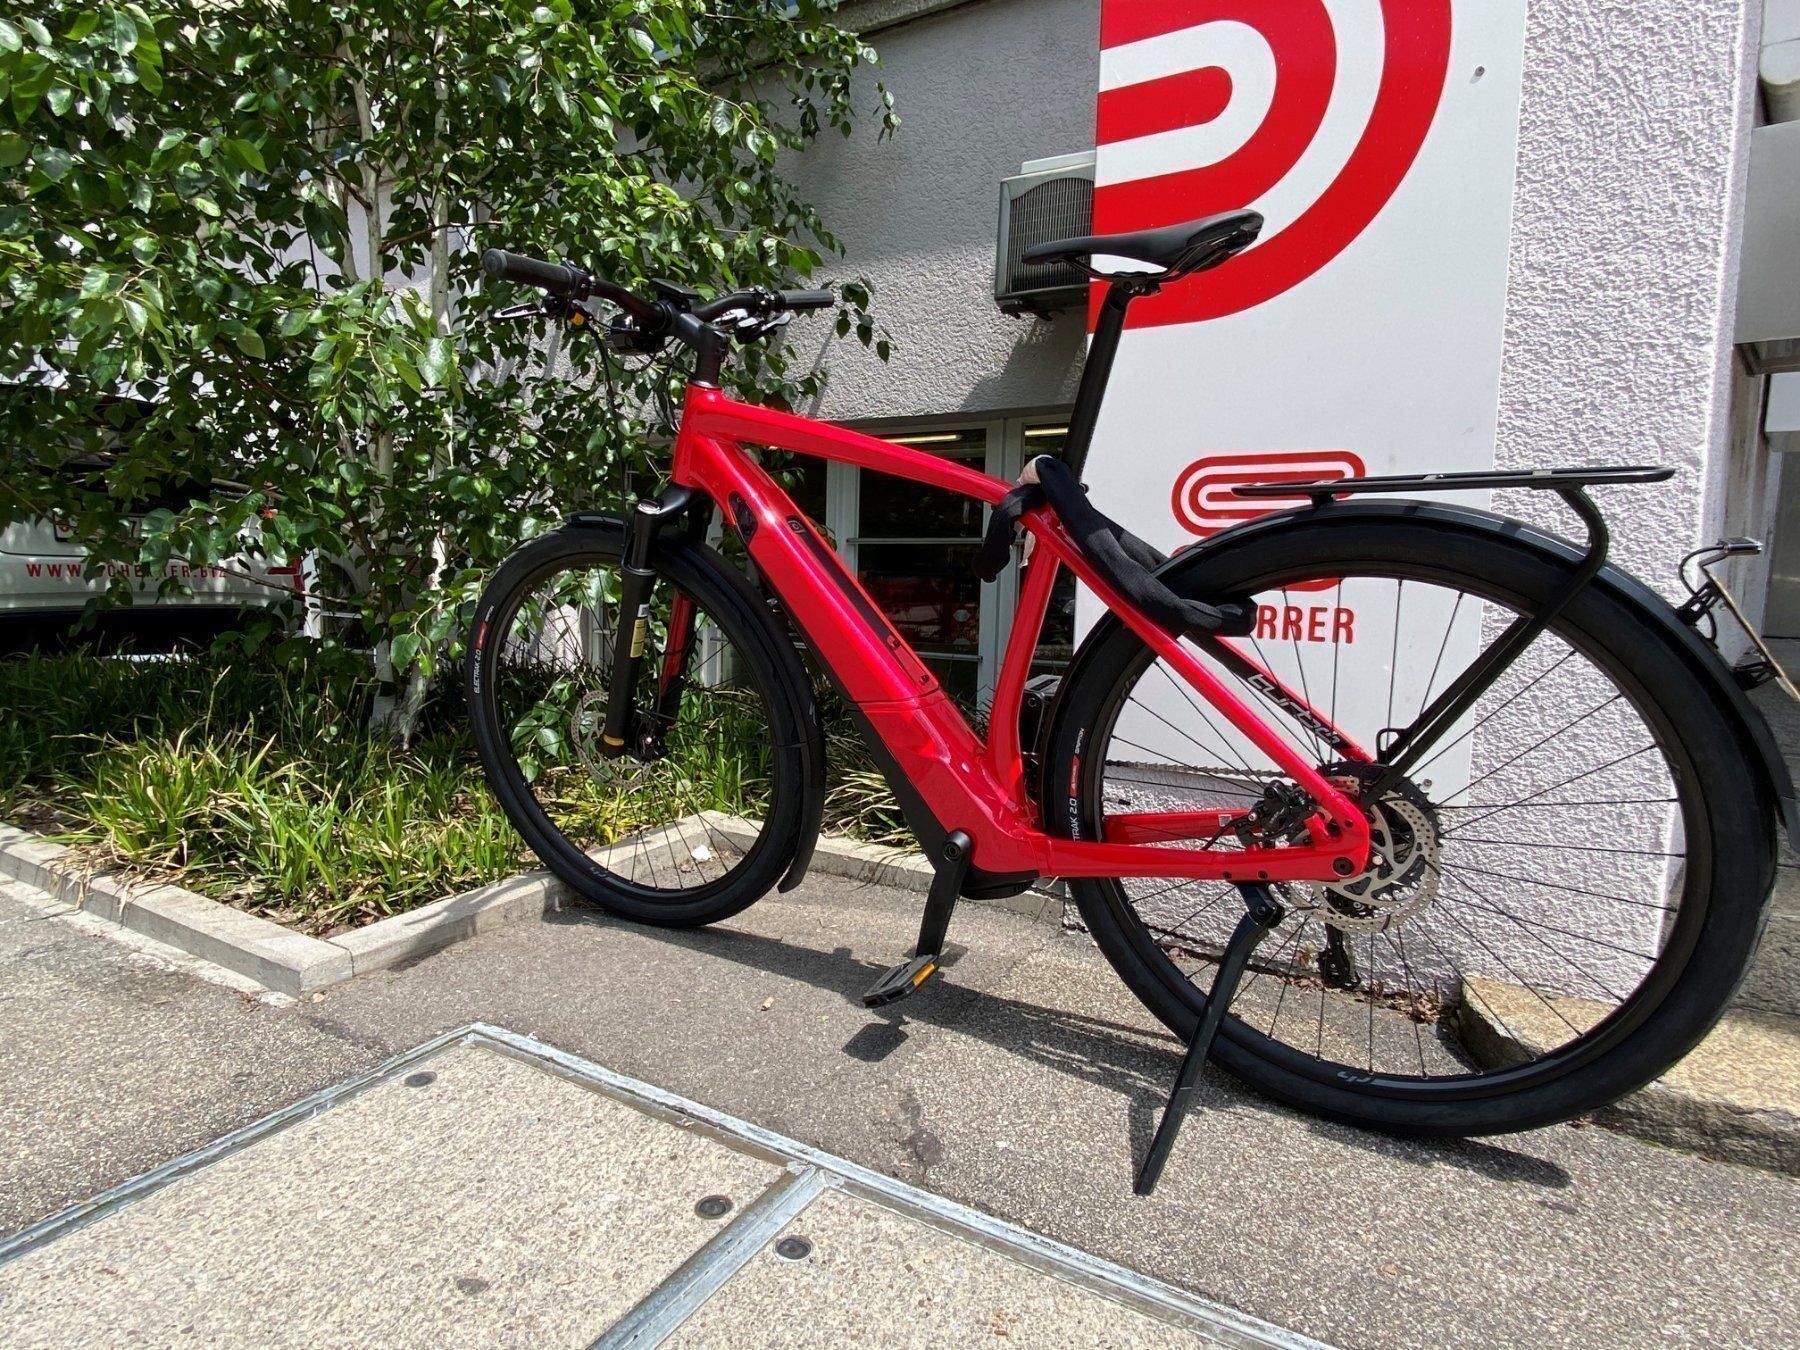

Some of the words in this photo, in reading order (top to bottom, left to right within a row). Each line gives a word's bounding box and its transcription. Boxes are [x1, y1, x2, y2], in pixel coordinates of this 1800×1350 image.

[26, 563, 227, 578] WWWCHEER.BIZ
[1256, 604, 1355, 644] RRER
[1069, 798, 1078, 814] 2.0
[1069, 815, 1081, 842] TRAK
